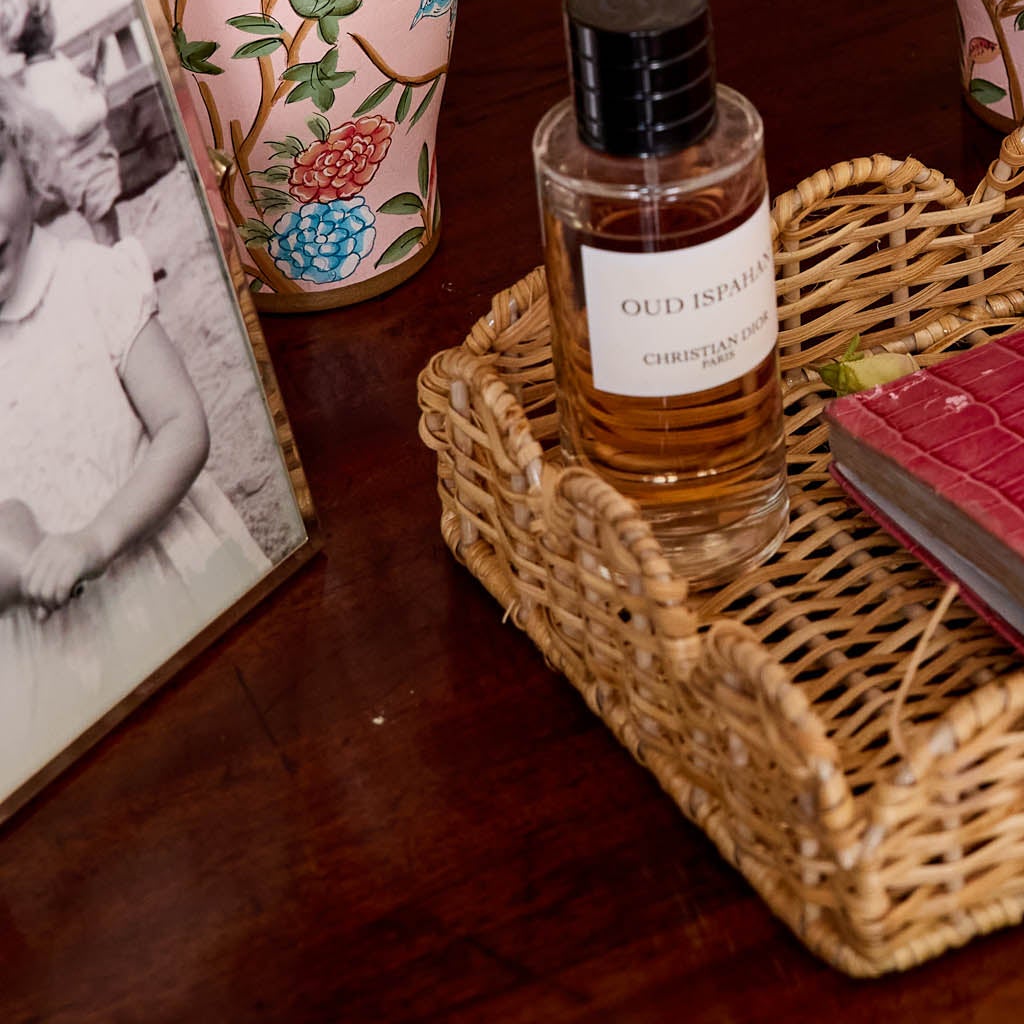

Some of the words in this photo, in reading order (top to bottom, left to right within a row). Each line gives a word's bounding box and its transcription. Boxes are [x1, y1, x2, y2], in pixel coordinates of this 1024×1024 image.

[621, 297, 684, 316] OUD
[693, 251, 771, 309] ISPAHAN
[643, 333, 739, 366] CHRISTIAN
[741, 310, 769, 341] DIOR
[702, 351, 736, 369] PARIS
